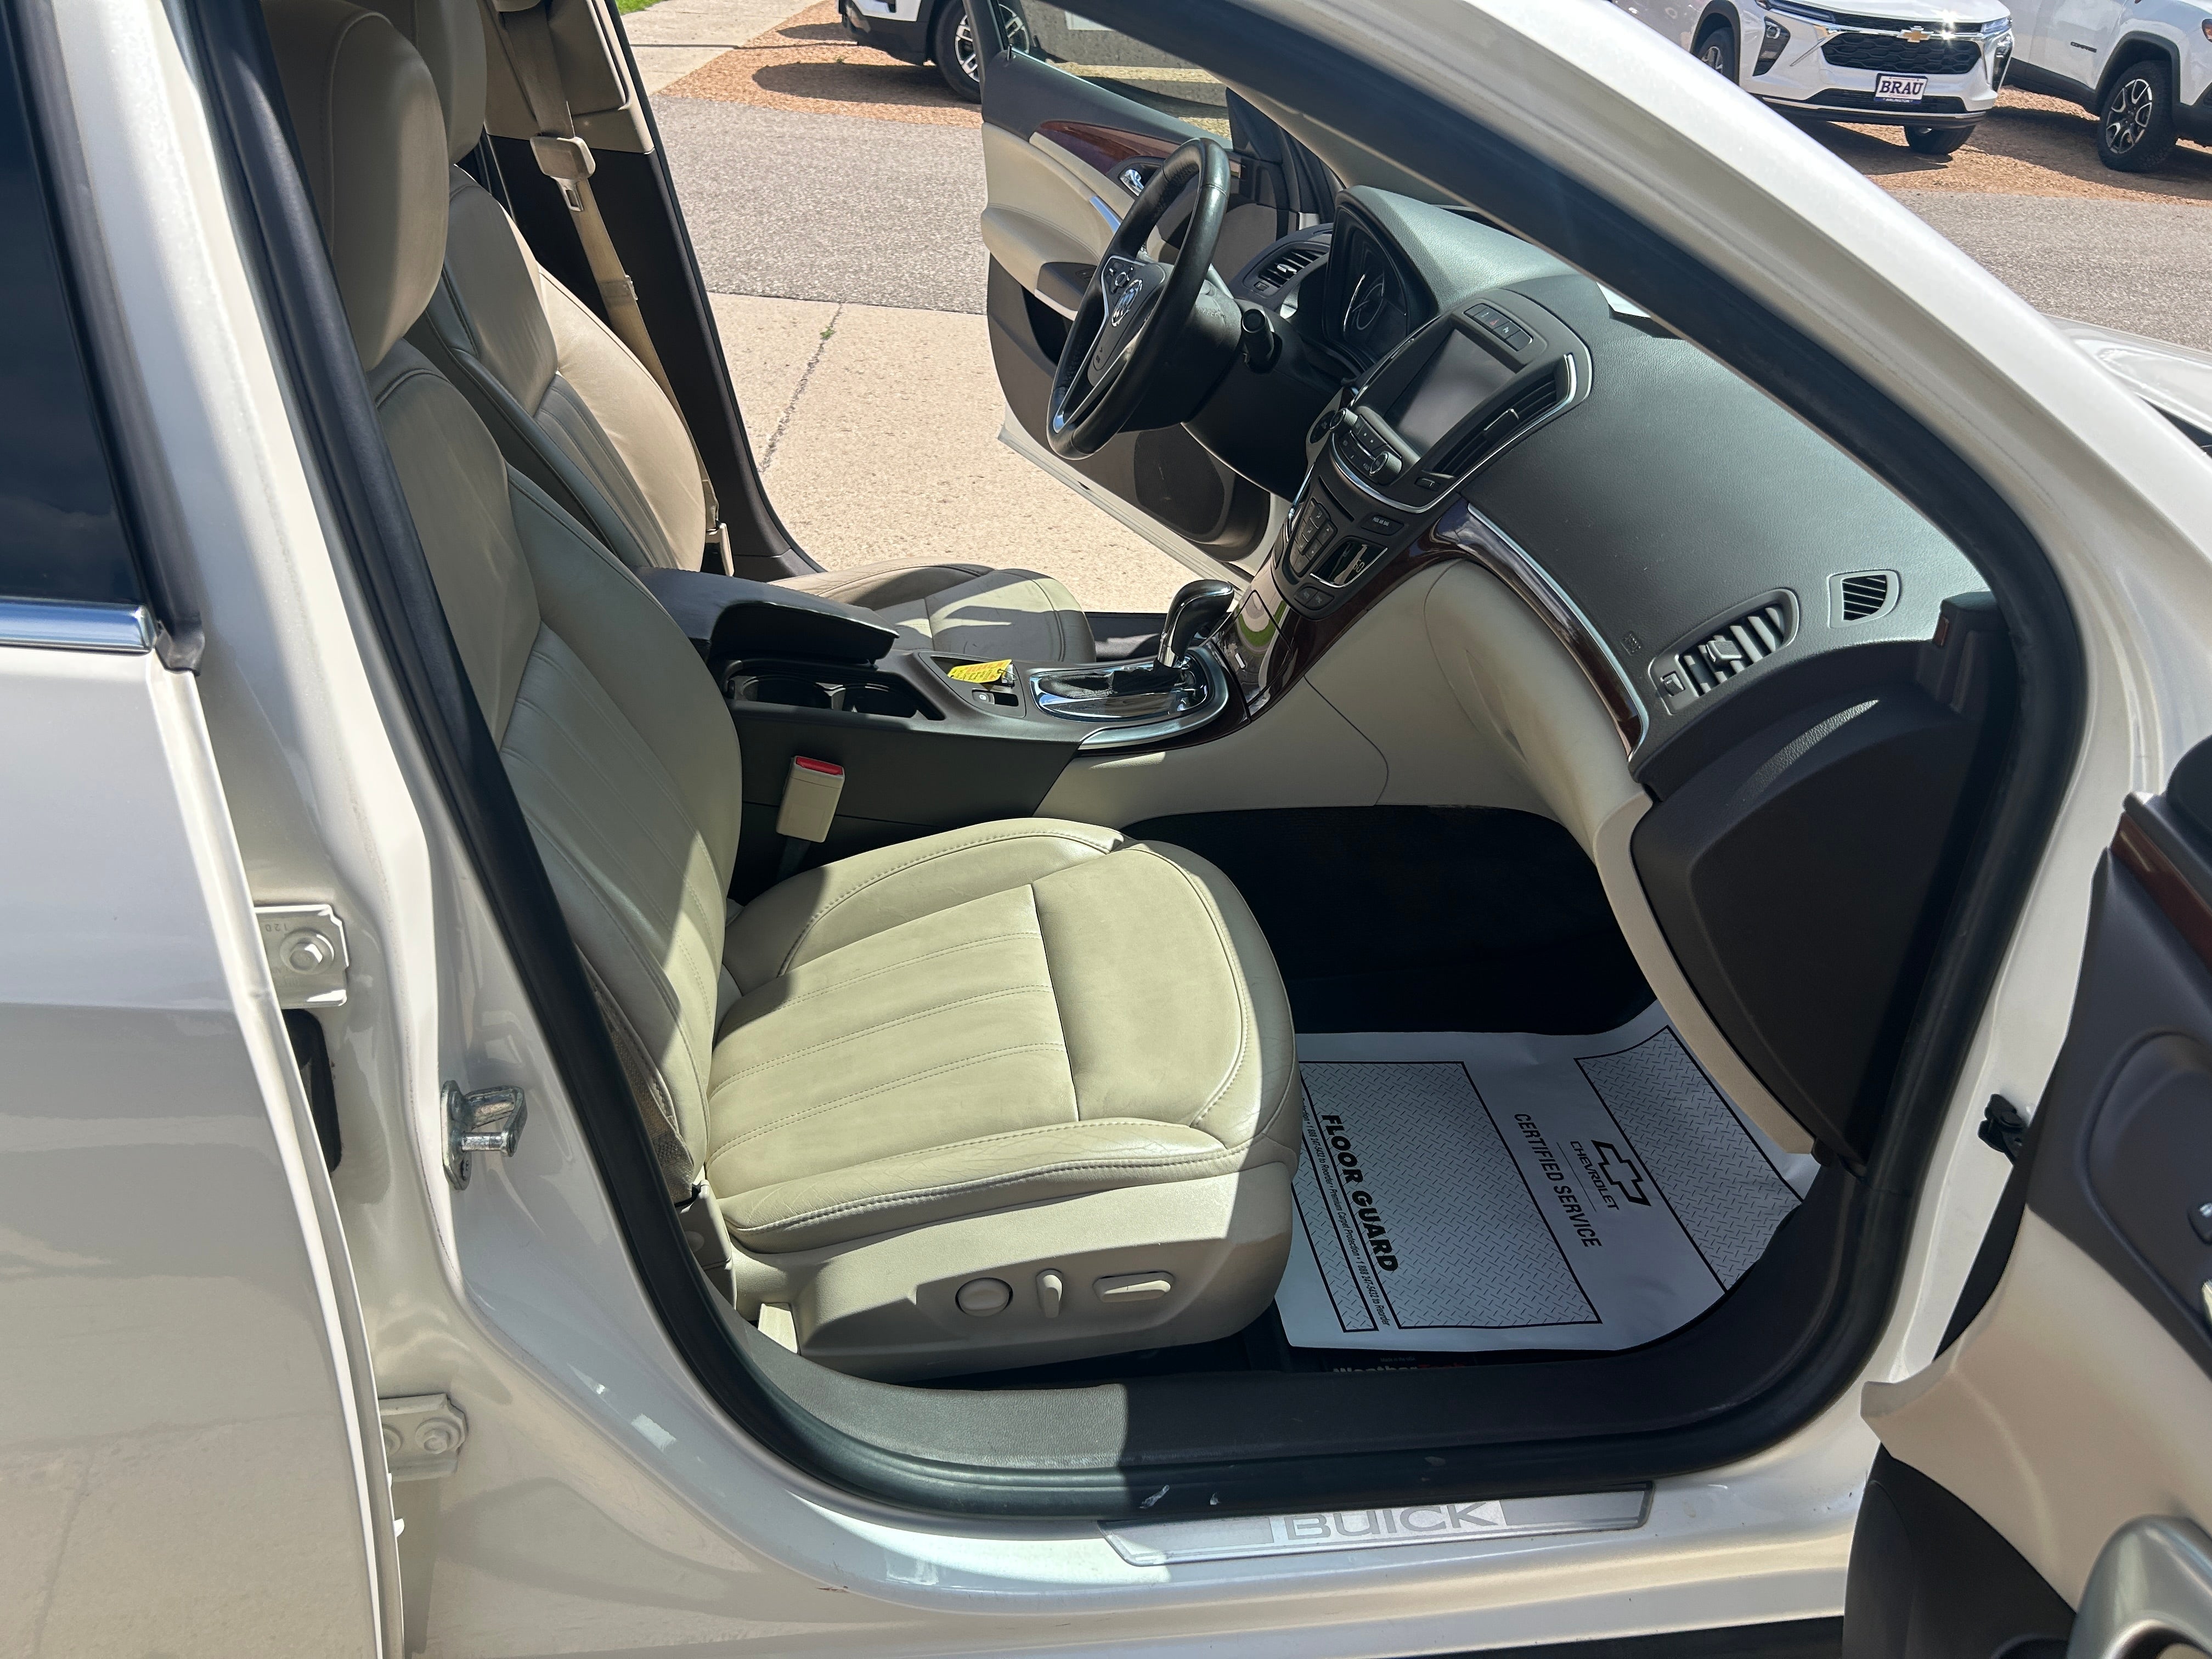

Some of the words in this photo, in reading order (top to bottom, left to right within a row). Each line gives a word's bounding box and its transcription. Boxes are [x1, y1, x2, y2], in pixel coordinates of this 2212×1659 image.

[1879, 81, 1924, 95] BRAU
[1321, 1115, 1364, 1184] FLOOR
[1352, 1190, 1398, 1272] GUARD
[1514, 1113, 1564, 1181] CERTIFIED
[1553, 1185, 1603, 1247] SERVICE
[1570, 1141, 1620, 1210] CHEVROLET
[1321, 1164, 1334, 1186] Reorder
[1329, 1188, 1343, 1211] Premium
[1338, 1211, 1350, 1231] Carpet
[1344, 1229, 1361, 1256] Protection
[1374, 1305, 1391, 1326] Reorder
[1284, 1502, 1498, 1540] BUICK
